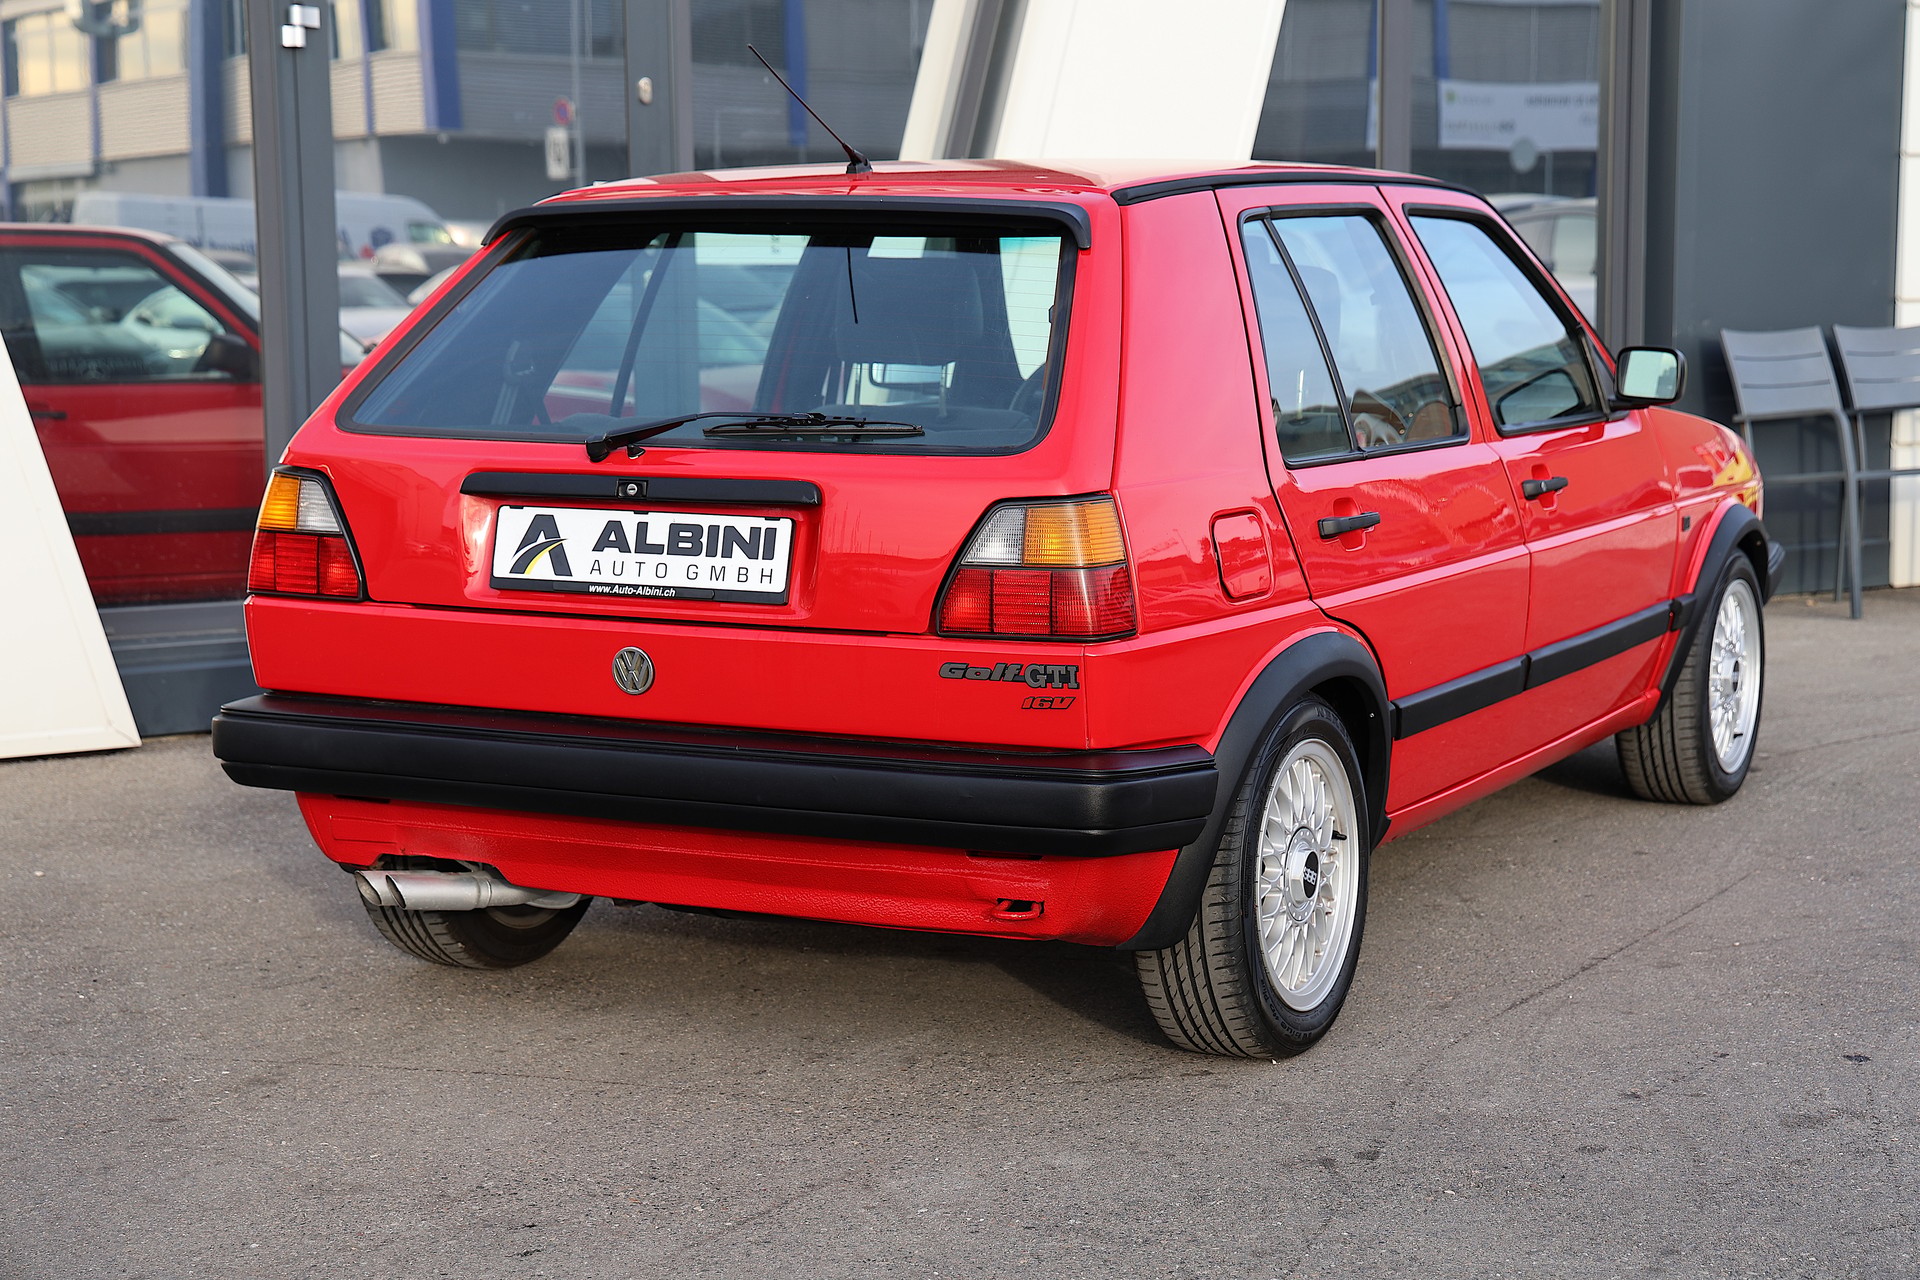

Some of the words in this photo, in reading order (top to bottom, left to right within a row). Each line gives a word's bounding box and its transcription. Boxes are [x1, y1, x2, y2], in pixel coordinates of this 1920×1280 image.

[592, 520, 778, 561] ALBINI
[590, 559, 668, 579] AUTO
[686, 564, 773, 584] GMBH
[588, 584, 676, 598] www.Auto-Albini.ch
[613, 648, 652, 693] VW
[939, 661, 1023, 682] Golf
[1023, 663, 1080, 690] GTI
[1021, 696, 1076, 710] 16V
